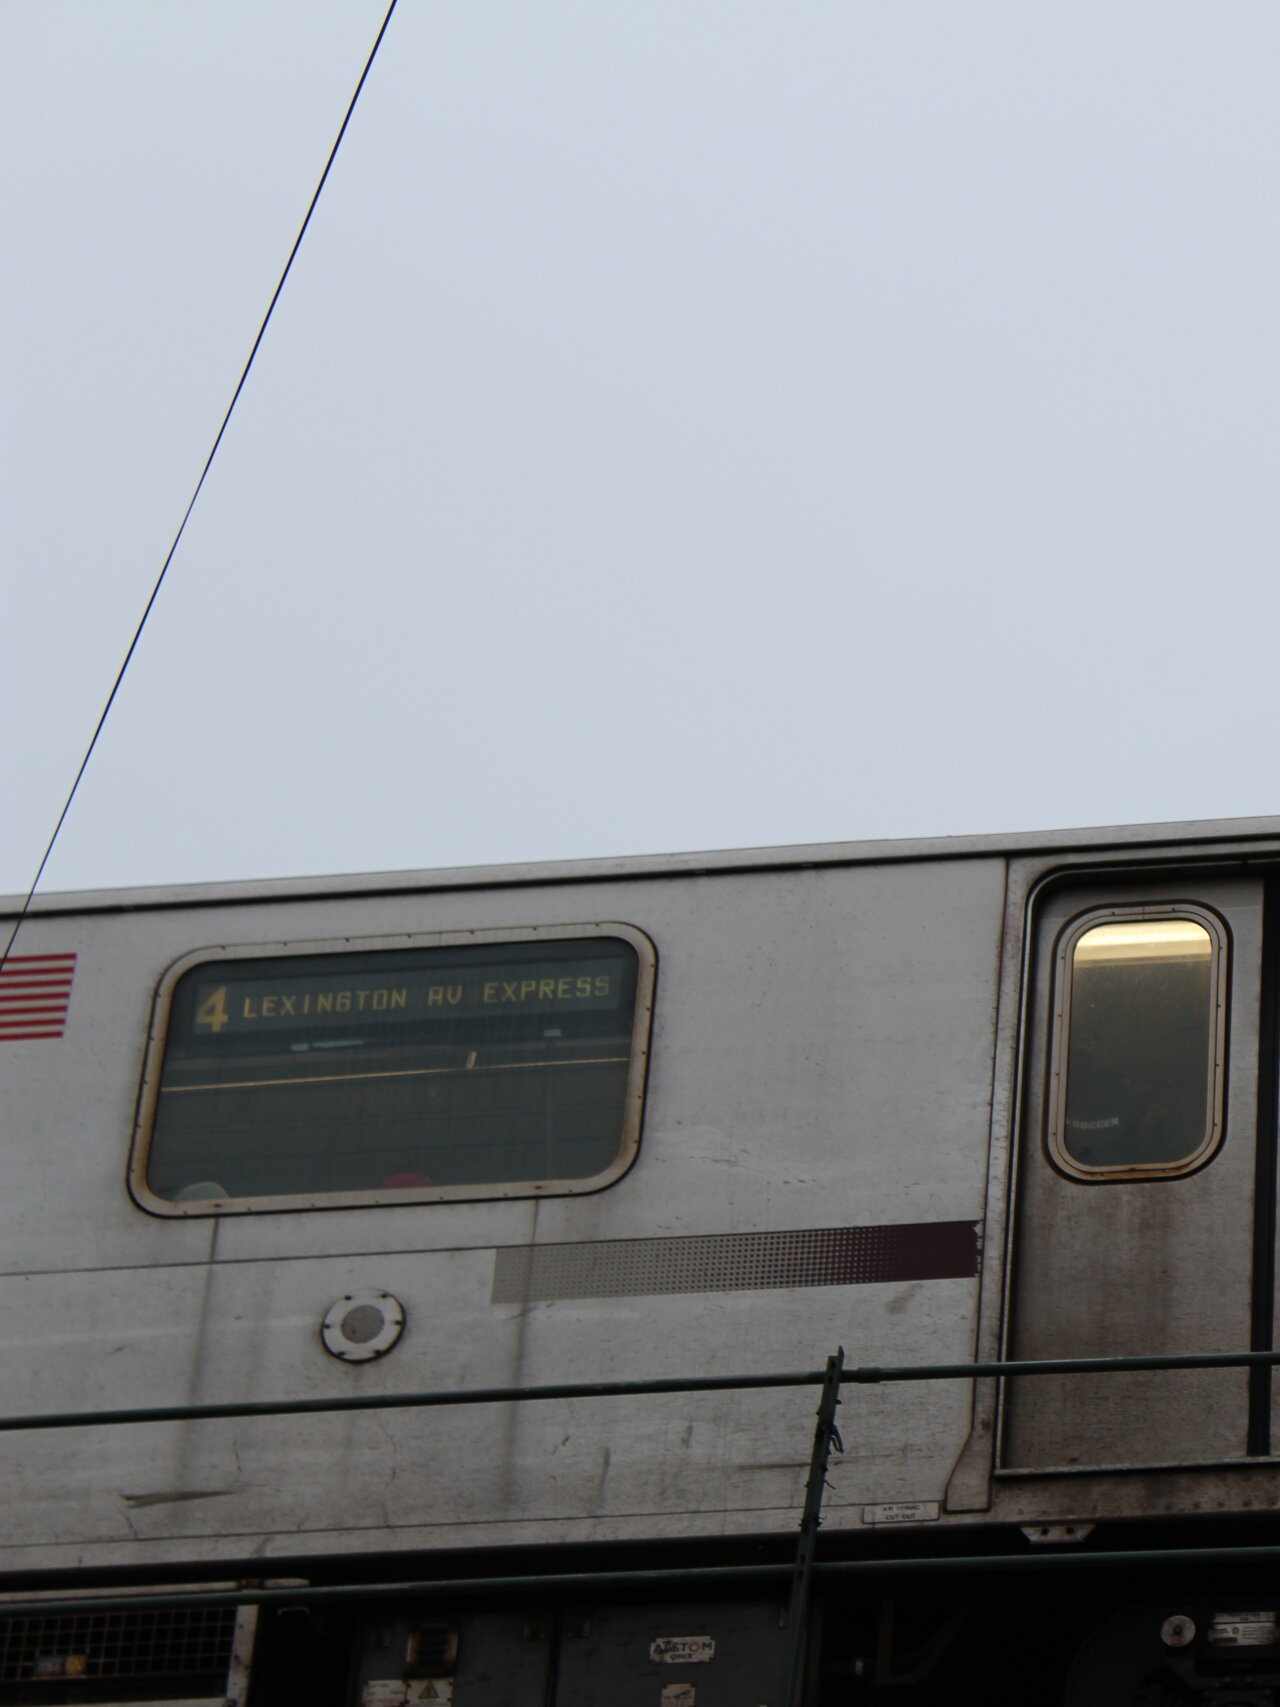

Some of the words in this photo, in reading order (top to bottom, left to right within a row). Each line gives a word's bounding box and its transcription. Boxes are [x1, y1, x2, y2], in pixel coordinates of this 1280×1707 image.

[195, 985, 229, 1033] 4
[244, 988, 407, 1018] LEXINGTON
[428, 985, 462, 1006] AV
[483, 976, 610, 1003] EXPRESS
